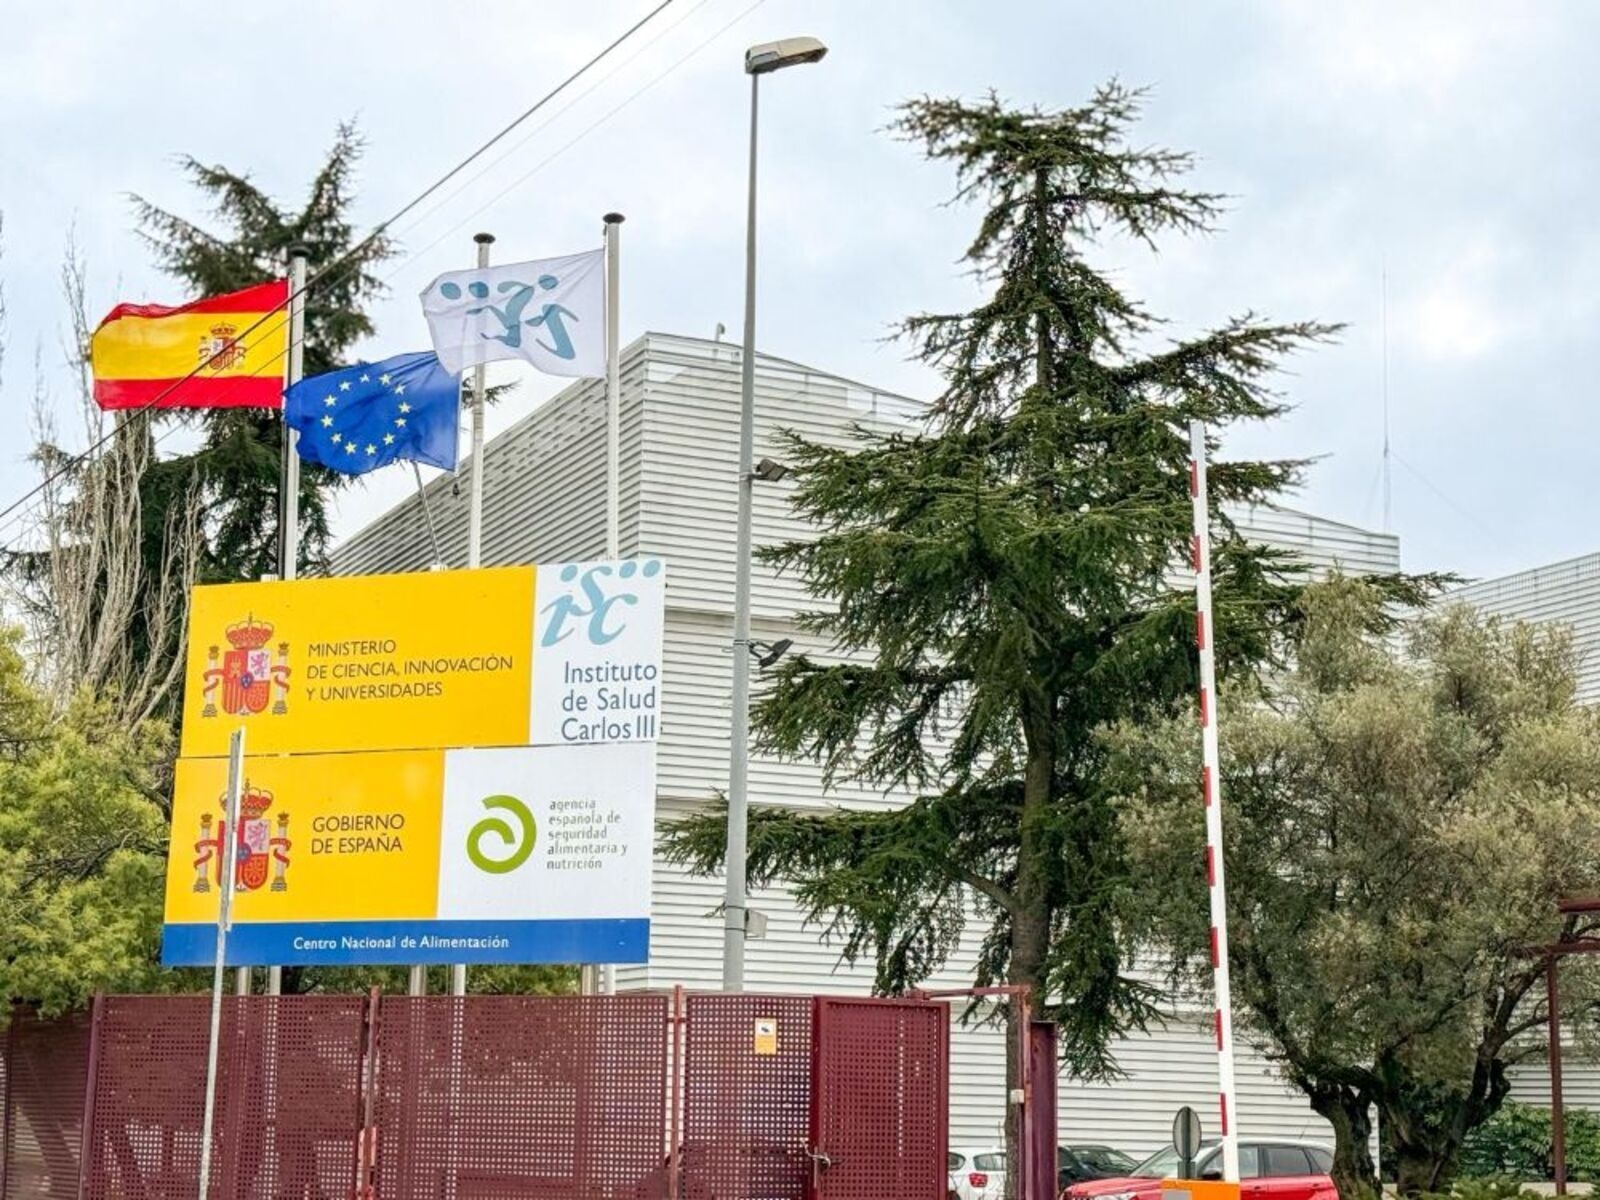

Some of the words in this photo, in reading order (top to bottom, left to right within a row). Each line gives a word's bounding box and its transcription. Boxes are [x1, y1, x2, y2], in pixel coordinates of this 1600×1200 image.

[308, 639, 396, 657] MINISTERIO
[306, 665, 328, 679] DE
[332, 661, 399, 678] CIENCIA,
[404, 653, 513, 675] INNOVACIÓN
[564, 660, 657, 684] Instituto
[306, 688, 316, 701] Y
[320, 681, 443, 701] UNIVERSIDADES
[562, 689, 588, 712] de
[597, 686, 656, 711] Salud
[561, 716, 631, 741] Carlos
[636, 715, 655, 738] III
[549, 800, 596, 813] agencia
[312, 813, 405, 833] GOBIERNO
[607, 810, 621, 823] de
[548, 825, 607, 842] seguridad
[311, 838, 333, 855] DE
[338, 832, 403, 853] ESPAÑA
[547, 840, 618, 855] alimentaria
[621, 844, 627, 857] y
[546, 856, 602, 870] nutrición
[293, 936, 337, 949] Centro
[341, 936, 396, 948] Nacional
[400, 936, 416, 948] de
[419, 935, 509, 948] Alimentación
